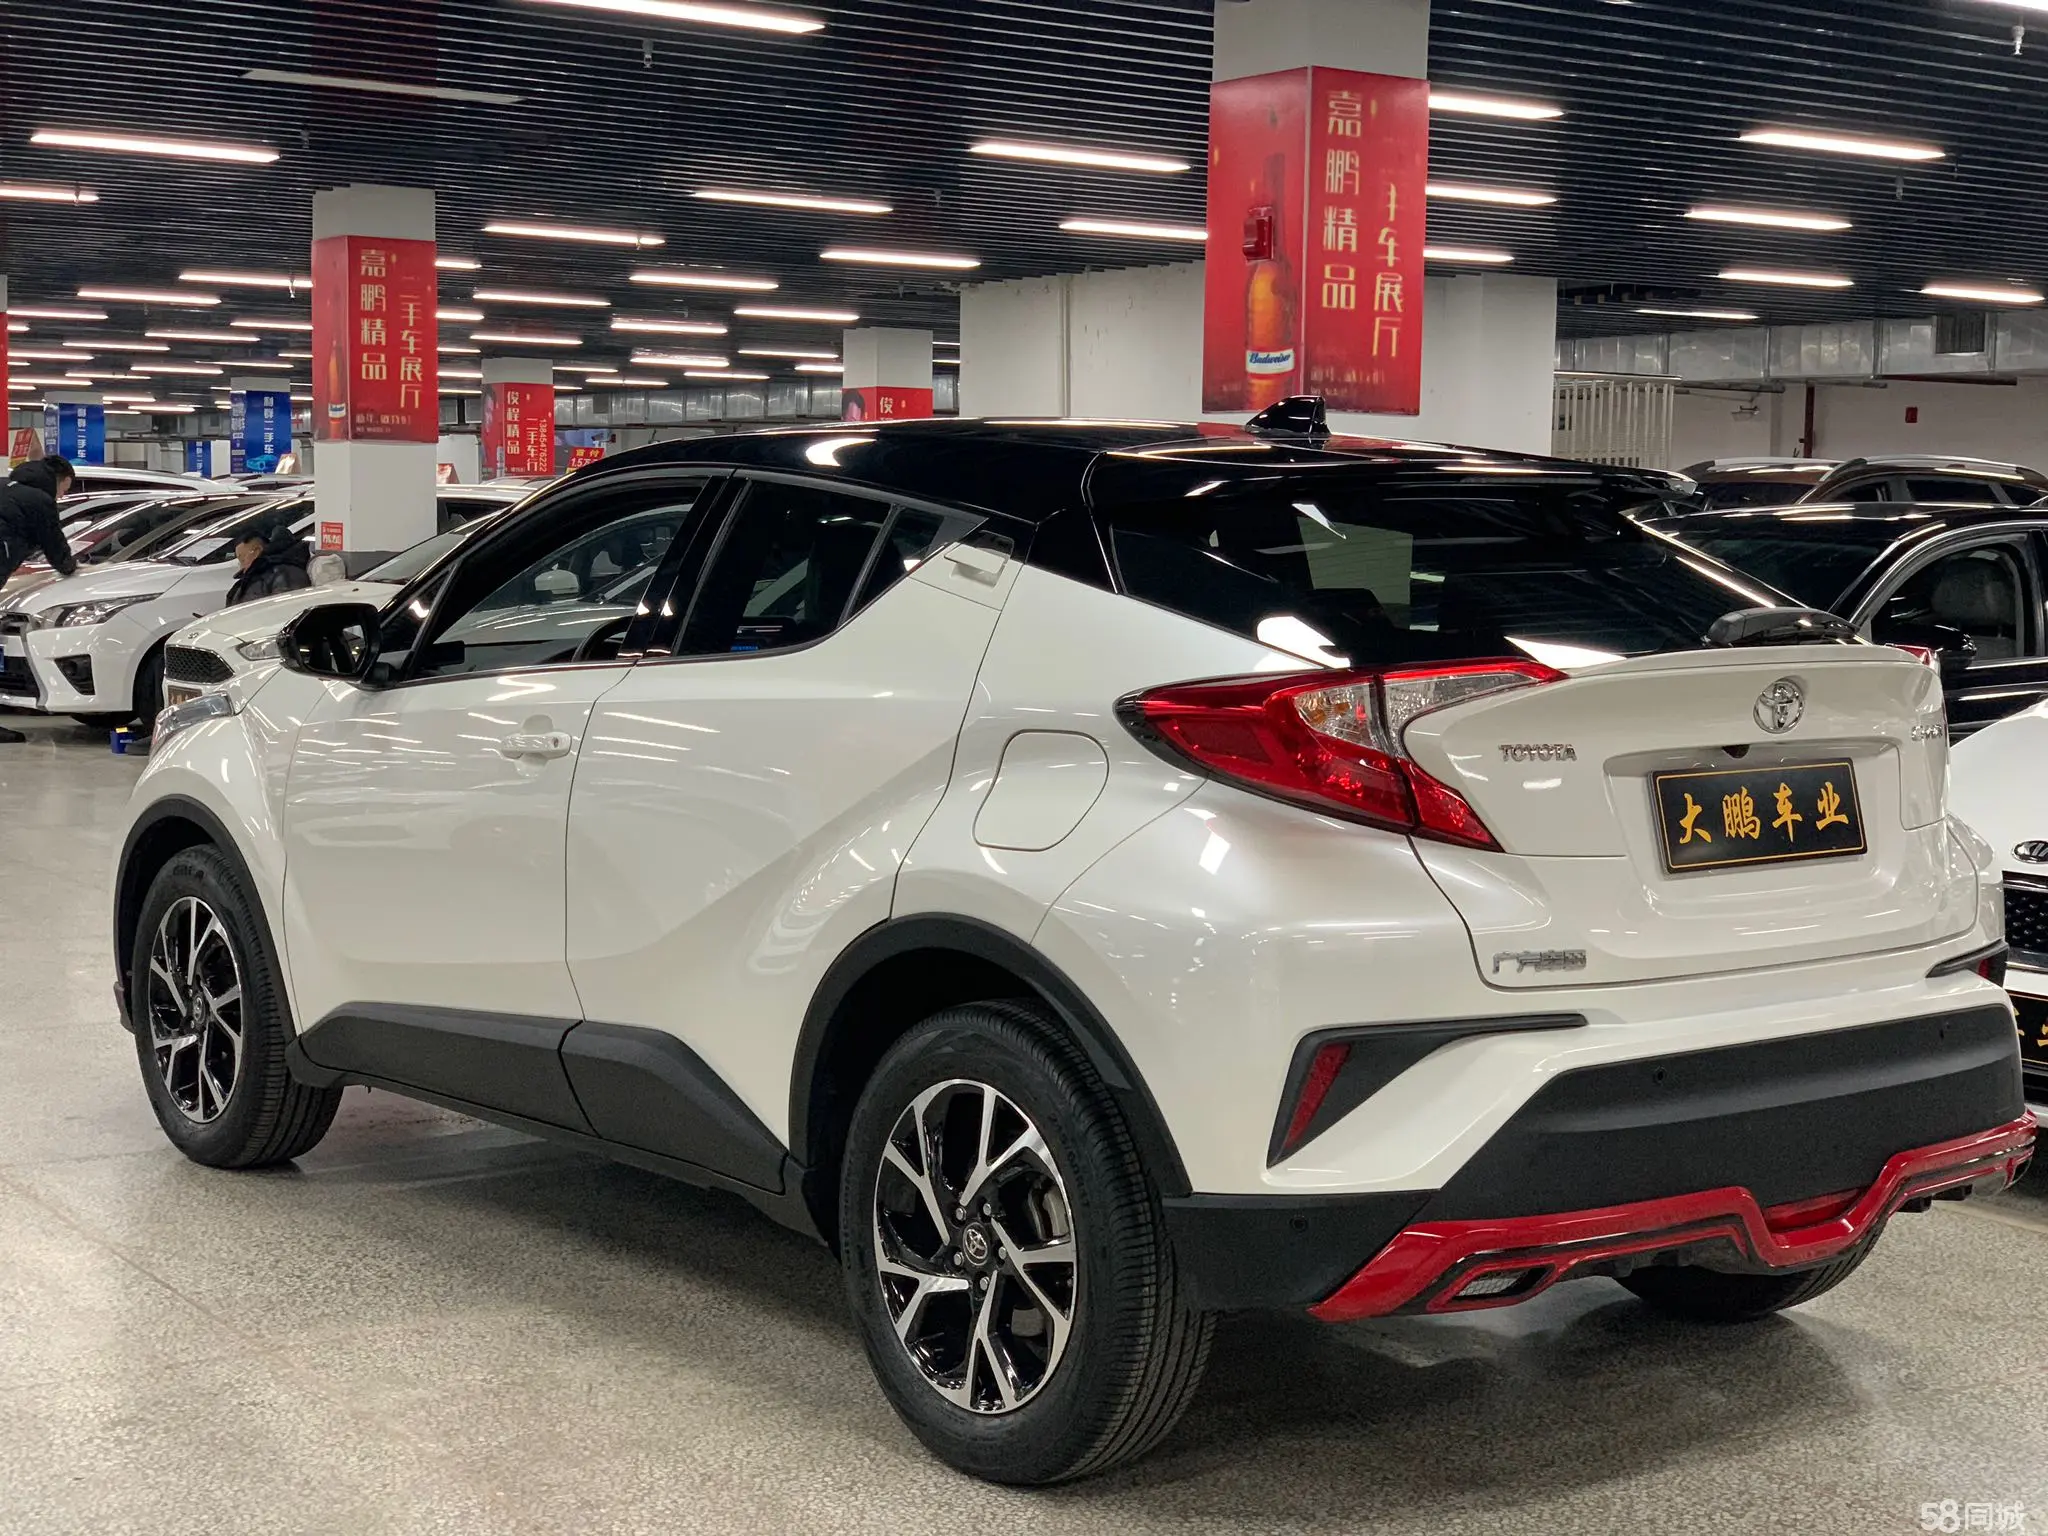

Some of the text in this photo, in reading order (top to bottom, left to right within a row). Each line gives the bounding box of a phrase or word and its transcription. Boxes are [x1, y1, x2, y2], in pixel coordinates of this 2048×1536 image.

[1322, 90, 1362, 310] 嘉鹏精品
[1372, 138, 1406, 358] 手车展厅
[361, 248, 387, 380] 嘉鹏精品
[1249, 352, 1291, 364] Budweiser
[507, 391, 520, 455] 俊程精品
[879, 396, 894, 421] 俊
[525, 417, 538, 472] 二手车行
[571, 458, 598, 467] 1.5万
[1498, 743, 1578, 762] TOYOTA
[1679, 781, 1849, 843] 大鹏车业
